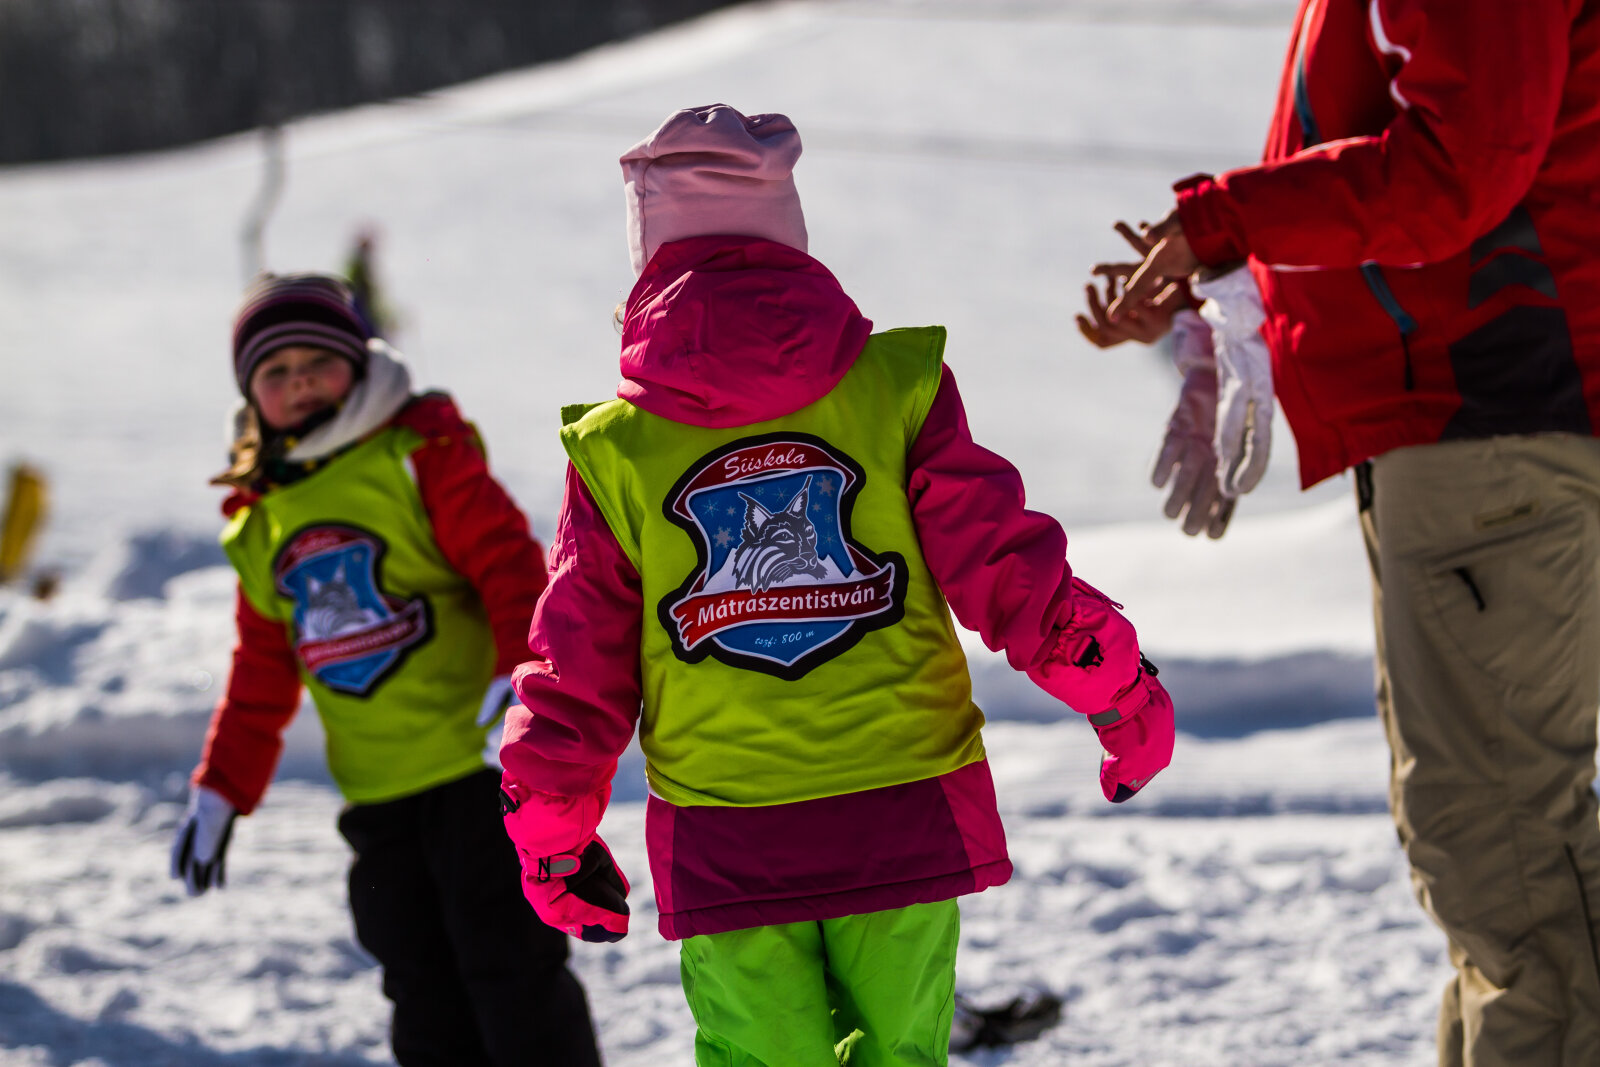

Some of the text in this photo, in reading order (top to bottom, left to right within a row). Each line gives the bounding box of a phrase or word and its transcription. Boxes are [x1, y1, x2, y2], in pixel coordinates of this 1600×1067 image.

[697, 584, 875, 627] Mátraszentistván
[781, 631, 802, 644] 800
[805, 630, 815, 638] m
